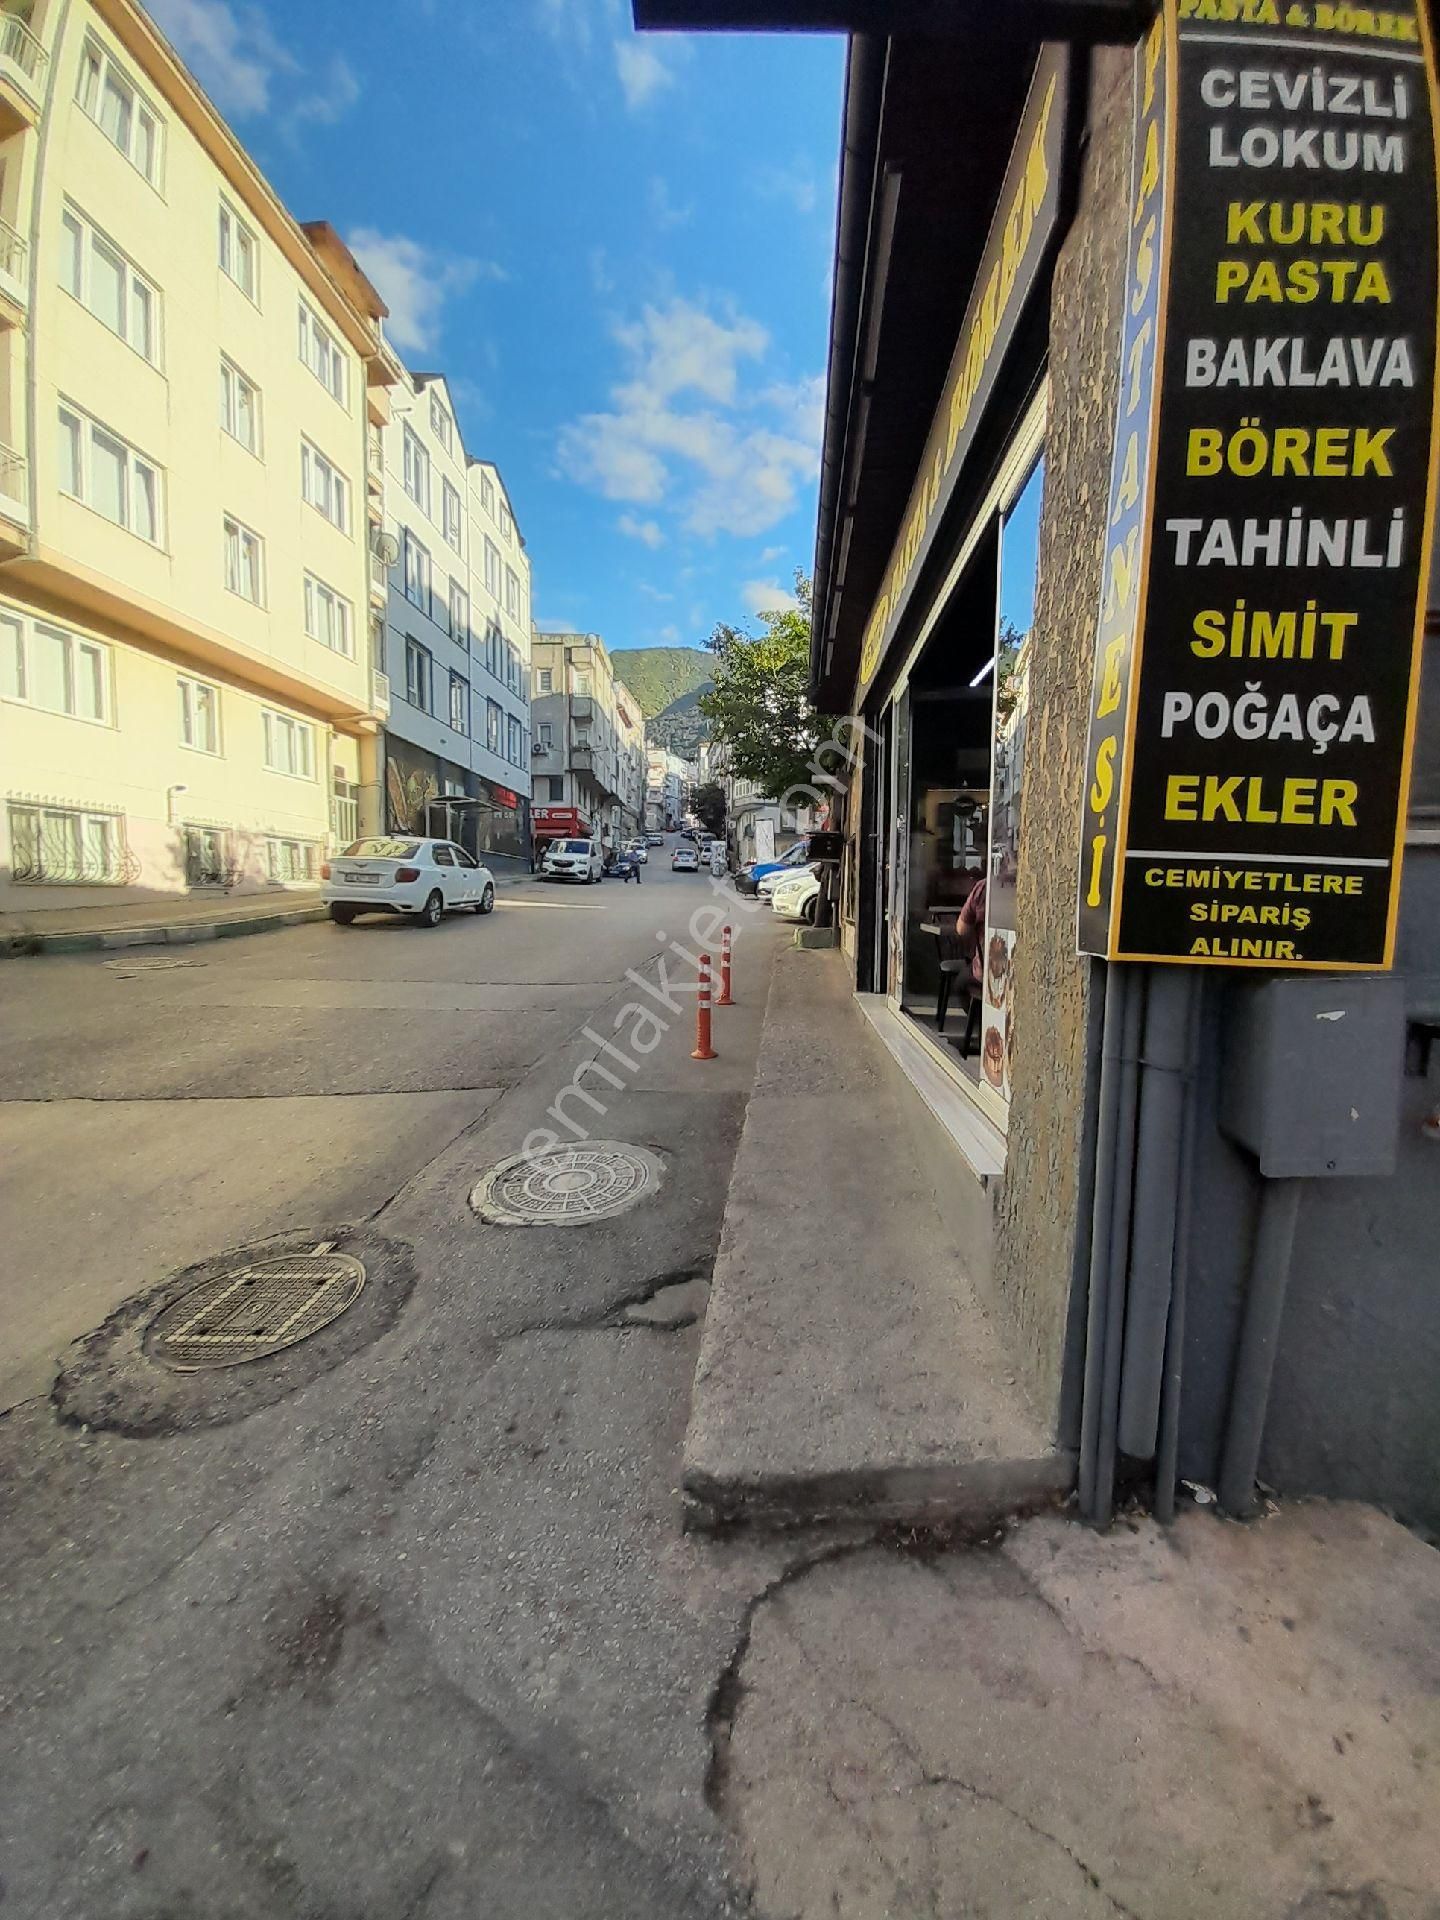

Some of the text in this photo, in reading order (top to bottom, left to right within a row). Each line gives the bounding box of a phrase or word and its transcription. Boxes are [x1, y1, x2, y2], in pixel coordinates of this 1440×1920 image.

[1177, 0, 1418, 42] PASTA & BÖREK
[1200, 66, 1408, 120] CEVİZLİ
[1208, 126, 1405, 174] LOKUM
[1225, 201, 1385, 246] KURU
[1214, 260, 1392, 304] PASTA
[1184, 337, 1415, 388] BAKLAVA
[1086, 10, 1164, 907] PASTANESİ
[1186, 418, 1396, 477] BÖREK
[1165, 507, 1404, 568] TAHİNLİ
[1190, 599, 1359, 660] SİMİT
[1161, 681, 1376, 755] POĞAÇA
[1163, 775, 1359, 827] EKLER
[1144, 866, 1363, 895] CEMİYETLERE
[1189, 902, 1311, 931] SİPARİŞ
[1189, 937, 1304, 960] ALINIR.
